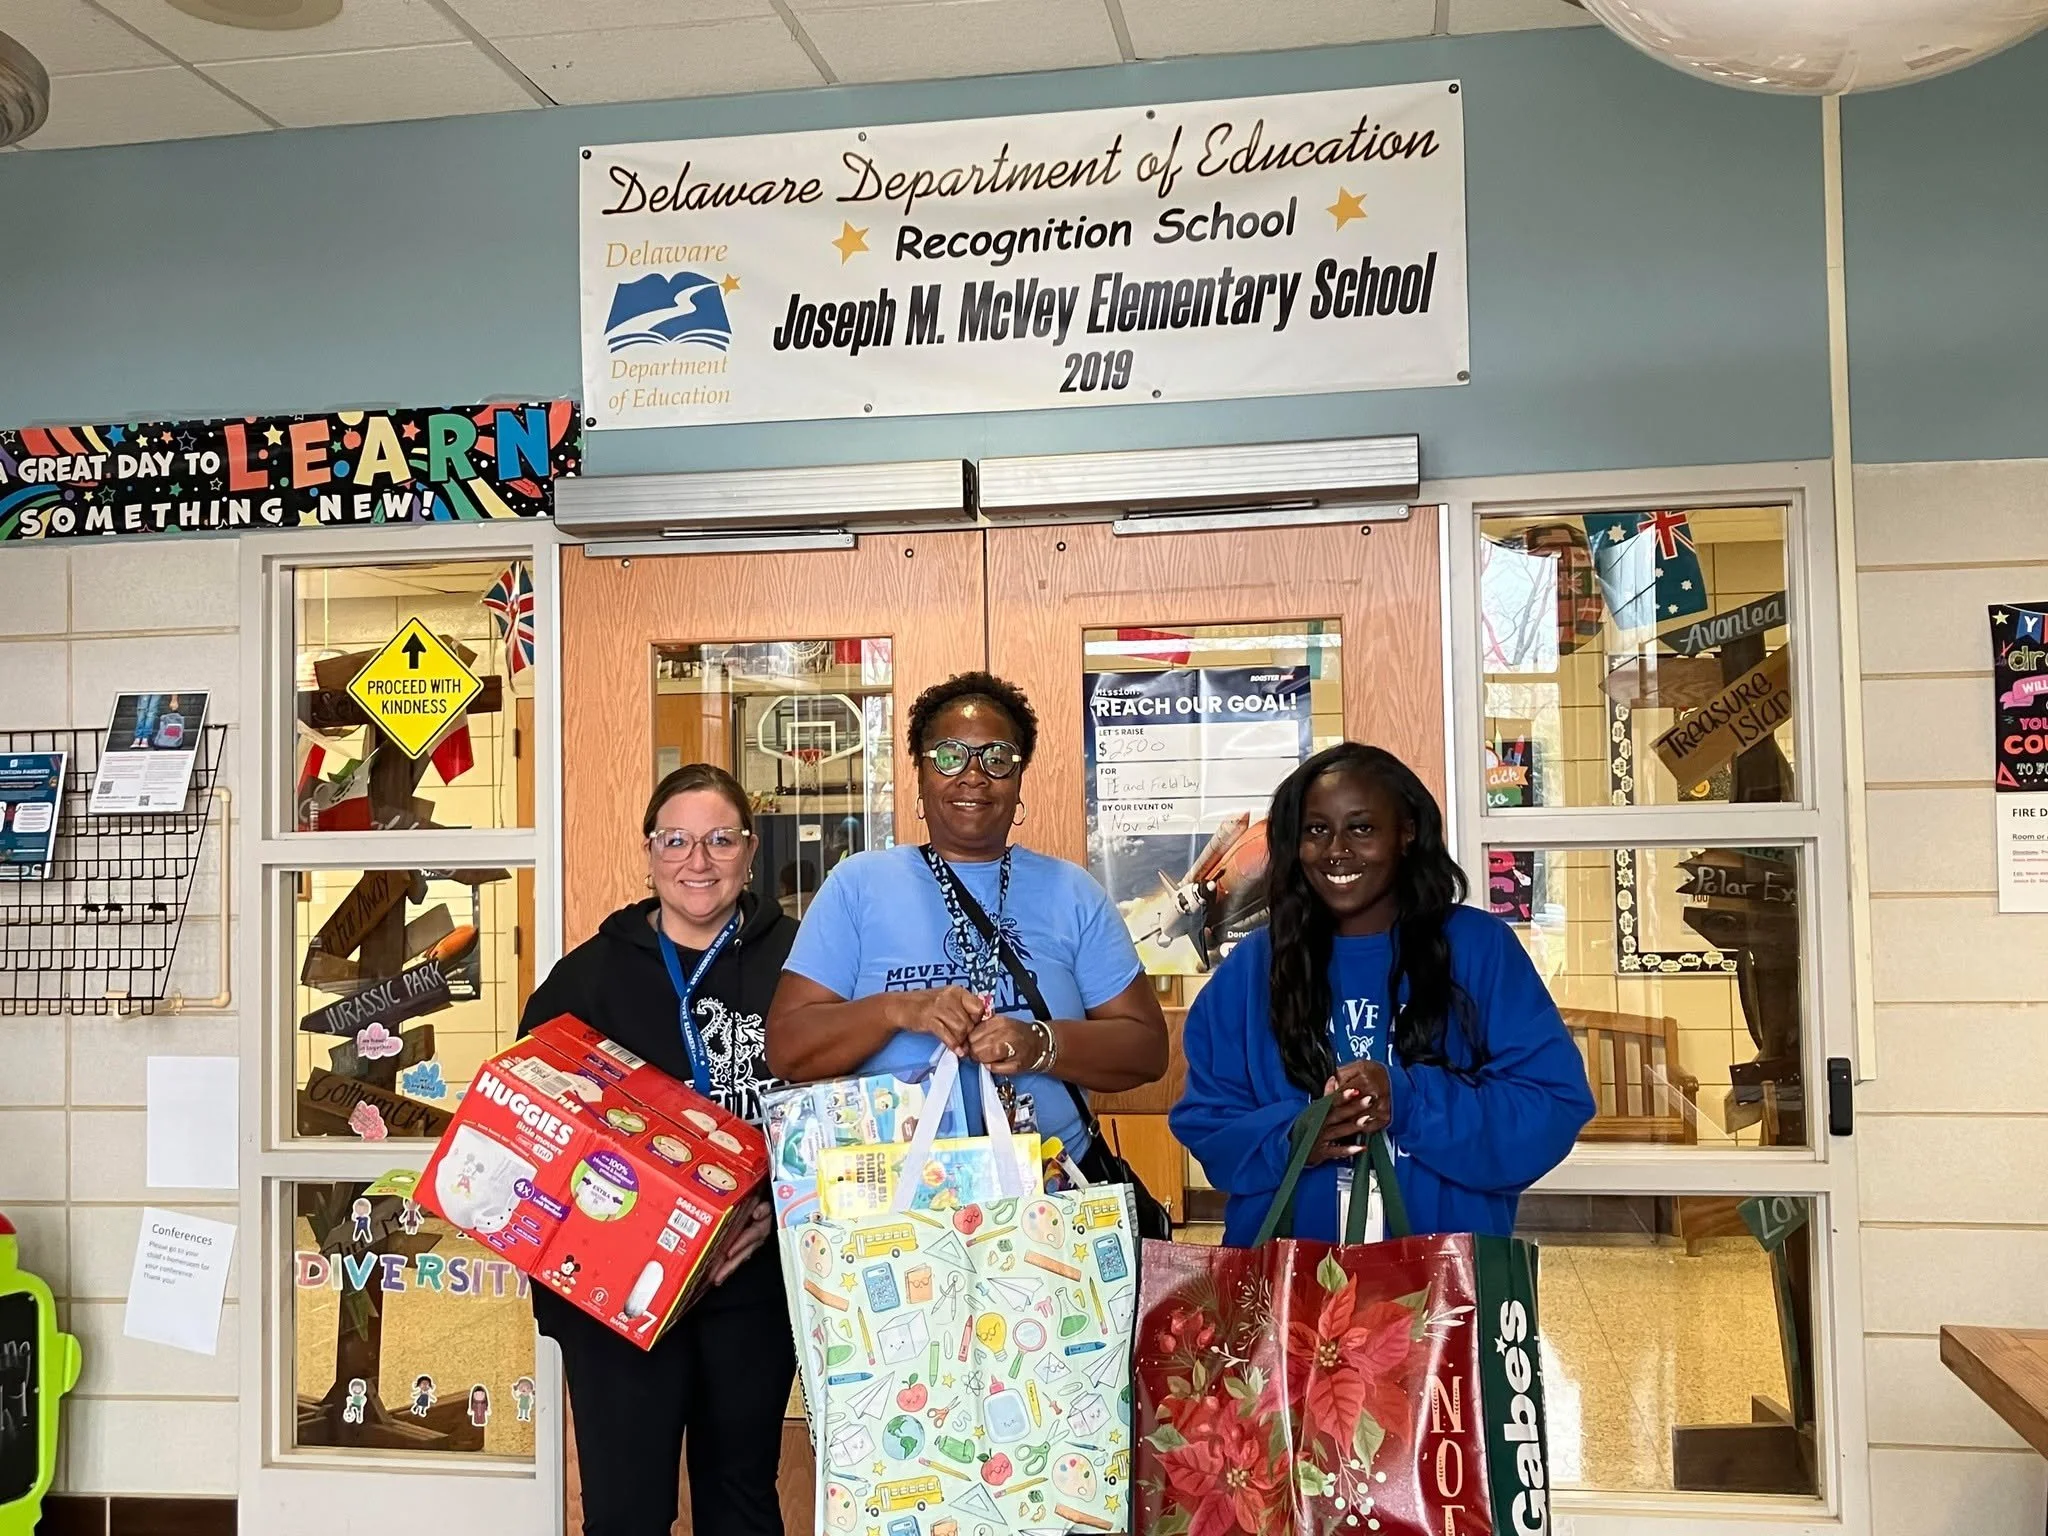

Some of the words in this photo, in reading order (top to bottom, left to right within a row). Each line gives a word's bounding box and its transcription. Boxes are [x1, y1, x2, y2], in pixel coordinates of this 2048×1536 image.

[602, 161, 823, 215] Delaware
[836, 134, 1122, 216] Department
[1137, 125, 1183, 198] of
[1197, 114, 1440, 177] Education
[896, 215, 1132, 267] Recognition
[1153, 196, 1298, 244] School
[606, 239, 728, 268] Delaware
[773, 288, 896, 356] Joseph
[904, 284, 945, 346] M.
[958, 277, 1080, 346] McVey
[1086, 266, 1302, 333] Elementary
[1310, 251, 1438, 319] School
[611, 356, 728, 382] Department
[1059, 349, 1134, 393] 2019
[608, 389, 630, 415] of
[633, 386, 731, 408] Education
[18, 454, 107, 484] GREAT
[118, 451, 174, 479] DAY
[185, 451, 221, 475] TO
[224, 408, 549, 492] LEARN
[20, 498, 282, 535] SOMETHING
[320, 491, 434, 521] NEW!
[1680, 598, 1785, 653] Avonlea
[368, 679, 426, 695] PROCEED
[431, 678, 461, 693] WITH
[1250, 673, 1280, 682] BOOSTER
[1096, 688, 1141, 697] Mission:
[382, 699, 447, 714] KINDNESS
[1096, 697, 1170, 717] REACH
[1175, 695, 1222, 715] OUR
[1227, 692, 1297, 712] GOAL!
[1121, 727, 1144, 736] RAISE
[1109, 737, 1165, 760] 2500
[1100, 767, 1117, 775] FOR
[1490, 766, 1520, 785] ack
[2016, 763, 2033, 775] TO
[1123, 778, 1145, 791] and
[1150, 774, 1179, 793] Field
[1133, 803, 1159, 811] EVENT
[2012, 808, 2036, 817] FIRE
[1697, 866, 1757, 896] Polar
[886, 963, 959, 982] MCVEY
[325, 980, 400, 1035] JURASSIC
[403, 961, 447, 998] PARK
[475, 1070, 574, 1146] HUGGIES
[608, 1157, 629, 1176] 100%
[516, 1180, 532, 1198] 4x
[149, 1240, 168, 1250] Please
[152, 1223, 212, 1246] Conferences
[143, 1271, 160, 1281] Thank
[296, 1252, 530, 1298] DIVERSITY
[637, 1311, 658, 1334] 7
[1496, 1300, 1549, 1536] Gabe's
